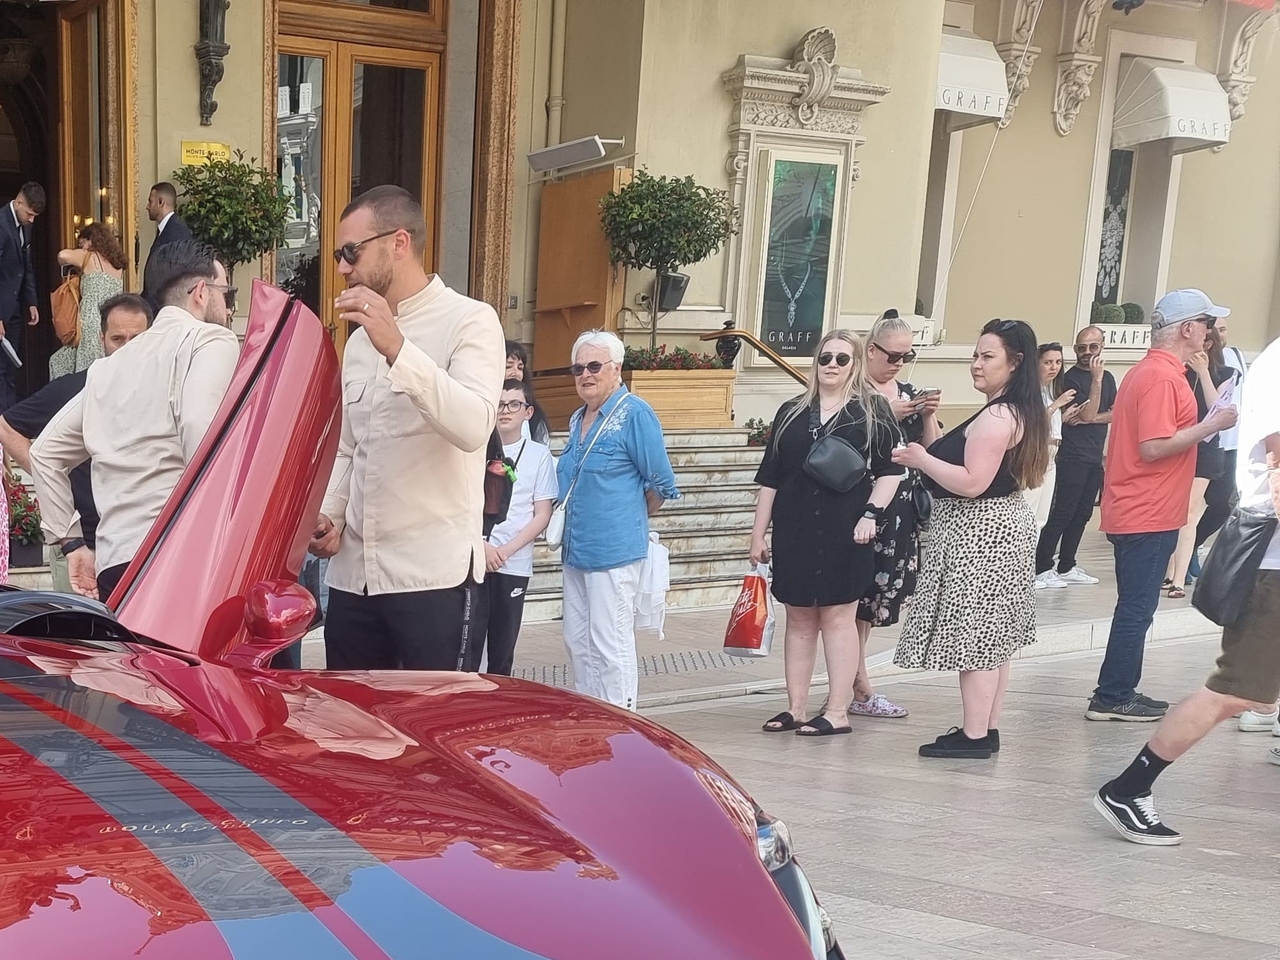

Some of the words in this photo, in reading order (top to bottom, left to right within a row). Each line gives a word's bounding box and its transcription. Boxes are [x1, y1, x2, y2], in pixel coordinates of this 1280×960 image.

[942, 88, 1005, 113] GRAFF
[1177, 118, 1229, 137] GRAFF
[768, 331, 812, 342] GRAFF
